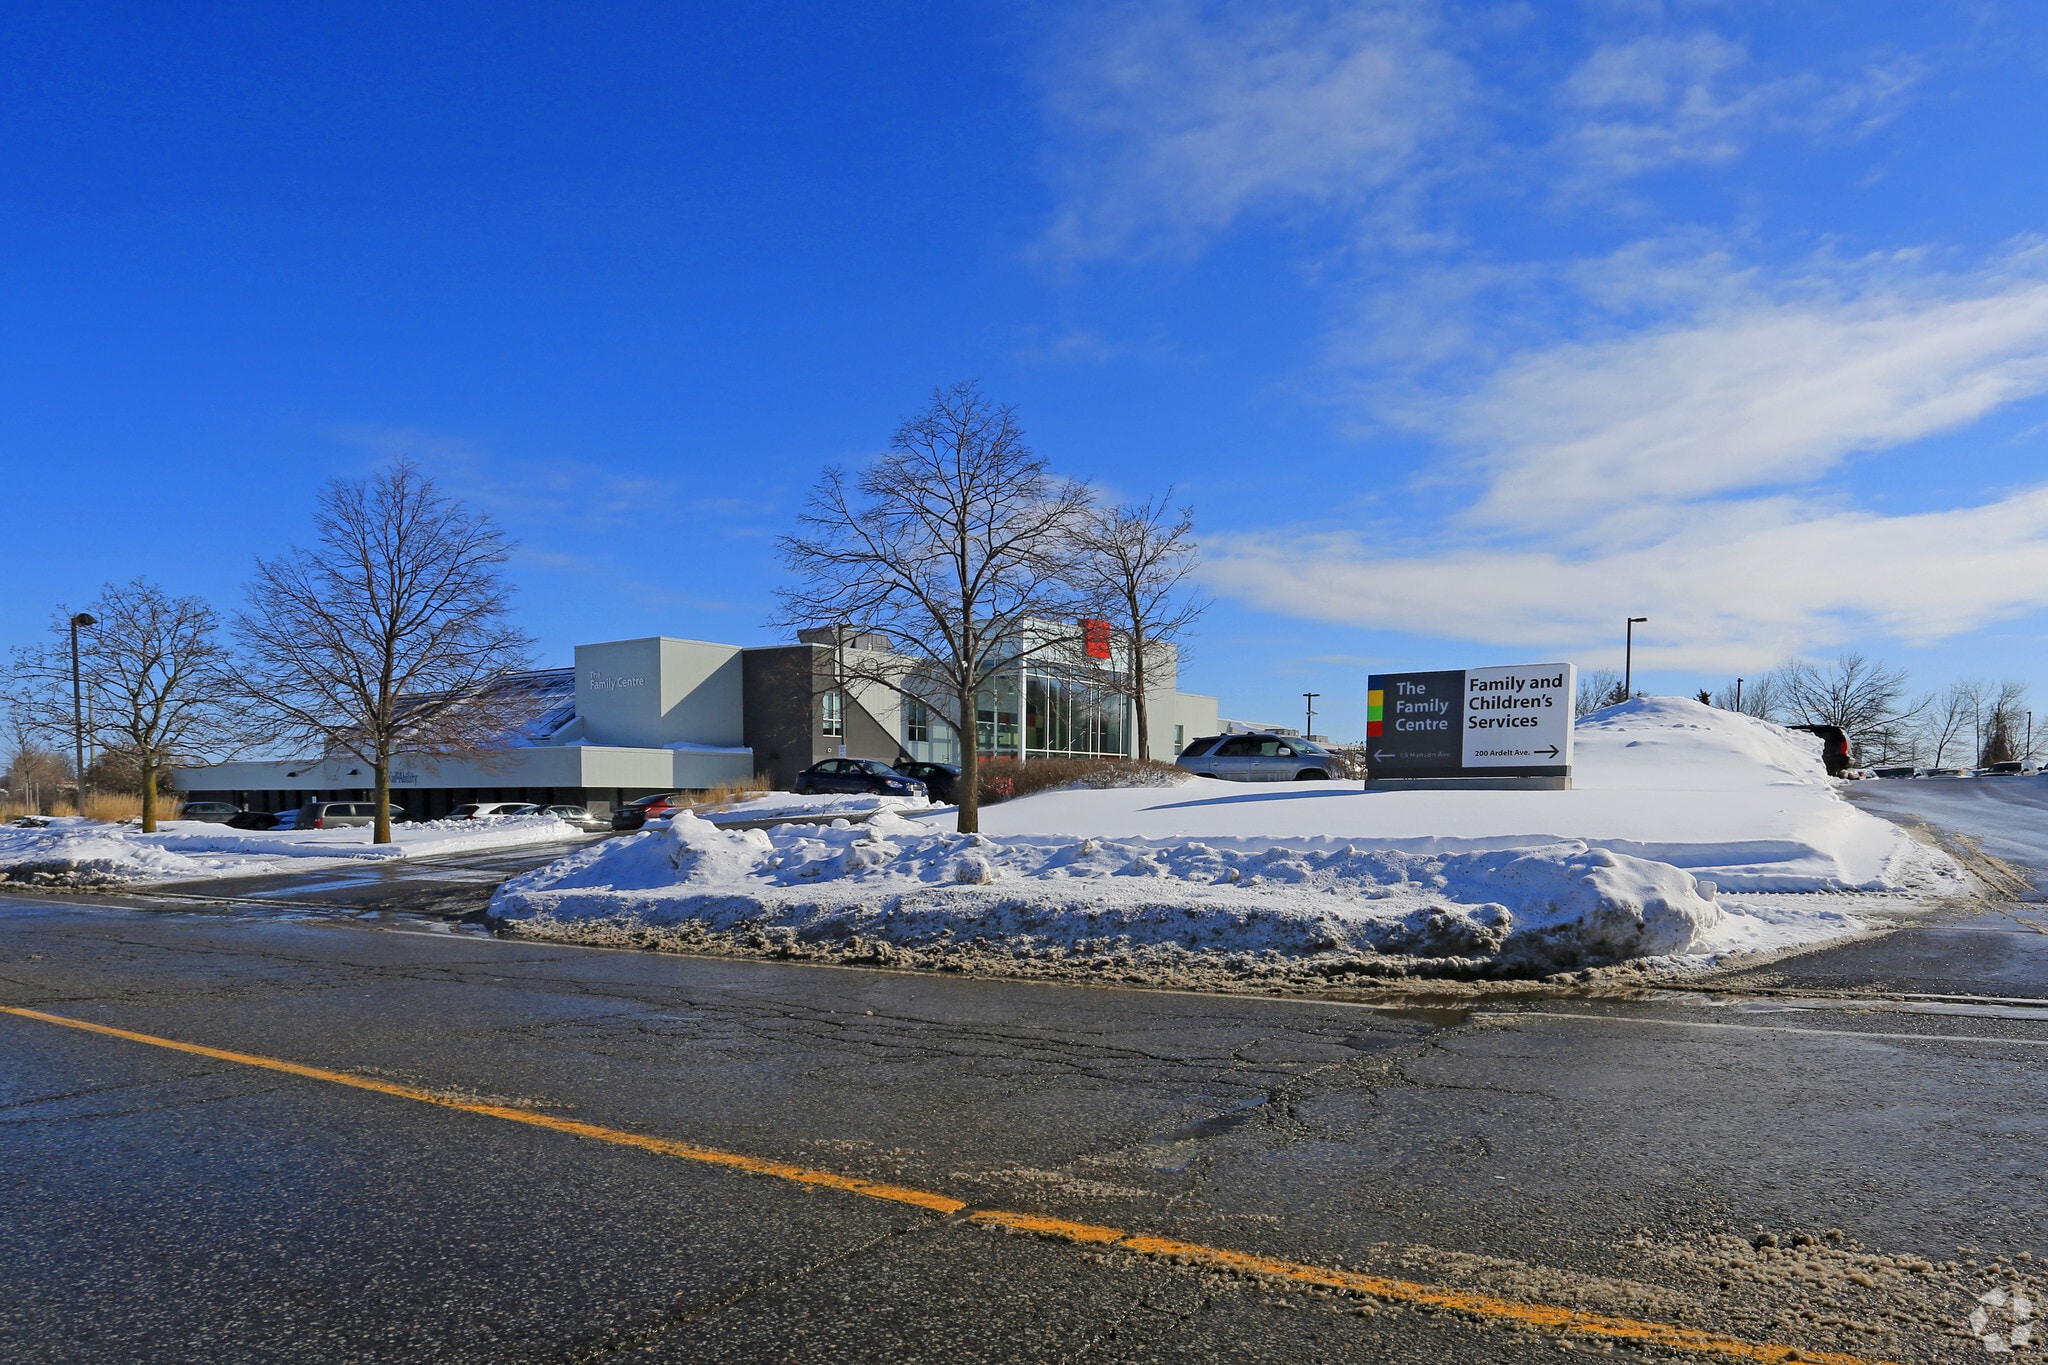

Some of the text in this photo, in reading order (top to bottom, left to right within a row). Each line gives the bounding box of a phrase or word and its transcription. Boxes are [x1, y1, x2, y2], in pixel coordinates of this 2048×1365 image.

[590, 677, 644, 691] Family Centre
[1396, 682, 1426, 695] The
[1470, 673, 1563, 693] Family and
[1396, 699, 1449, 715] Family
[1469, 693, 1553, 710] Children's
[1395, 717, 1449, 731] Centre
[1468, 714, 1538, 729] Services
[1489, 749, 1513, 757] Ardelt
